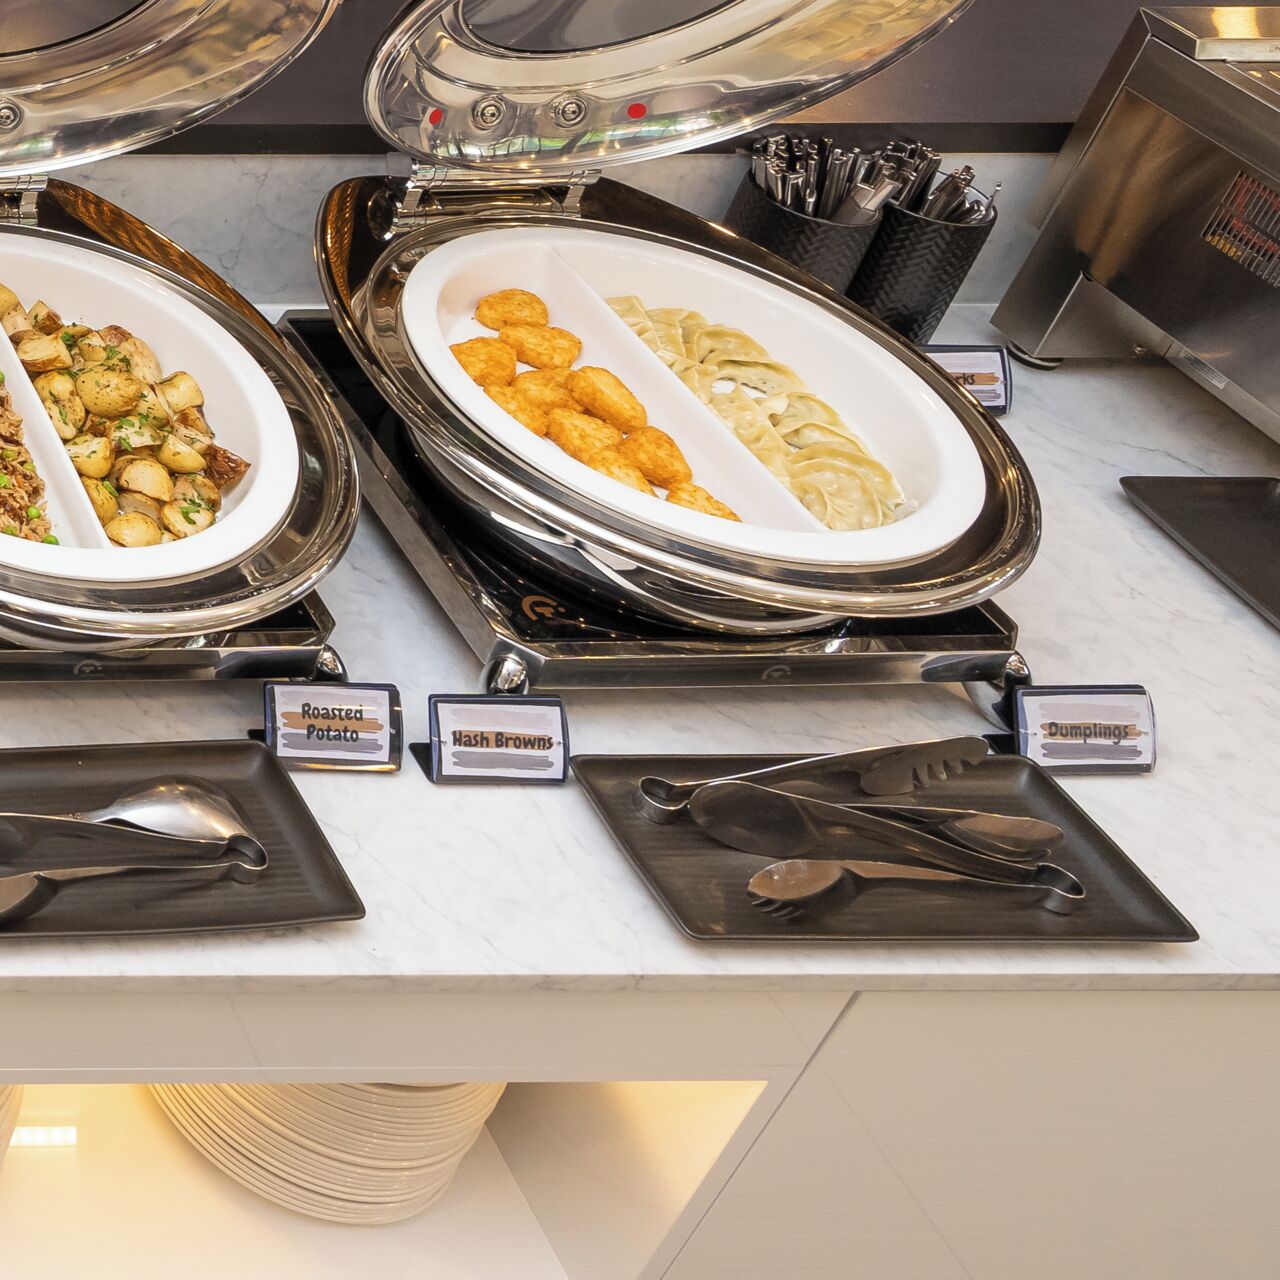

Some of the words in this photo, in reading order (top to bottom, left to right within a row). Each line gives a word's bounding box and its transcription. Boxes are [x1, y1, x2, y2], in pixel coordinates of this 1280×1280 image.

[301, 702, 363, 722] Roasted
[306, 723, 359, 742] Potato
[452, 731, 490, 749] Hash
[494, 732, 554, 750] Browns
[1047, 721, 1129, 745] Dumplings
